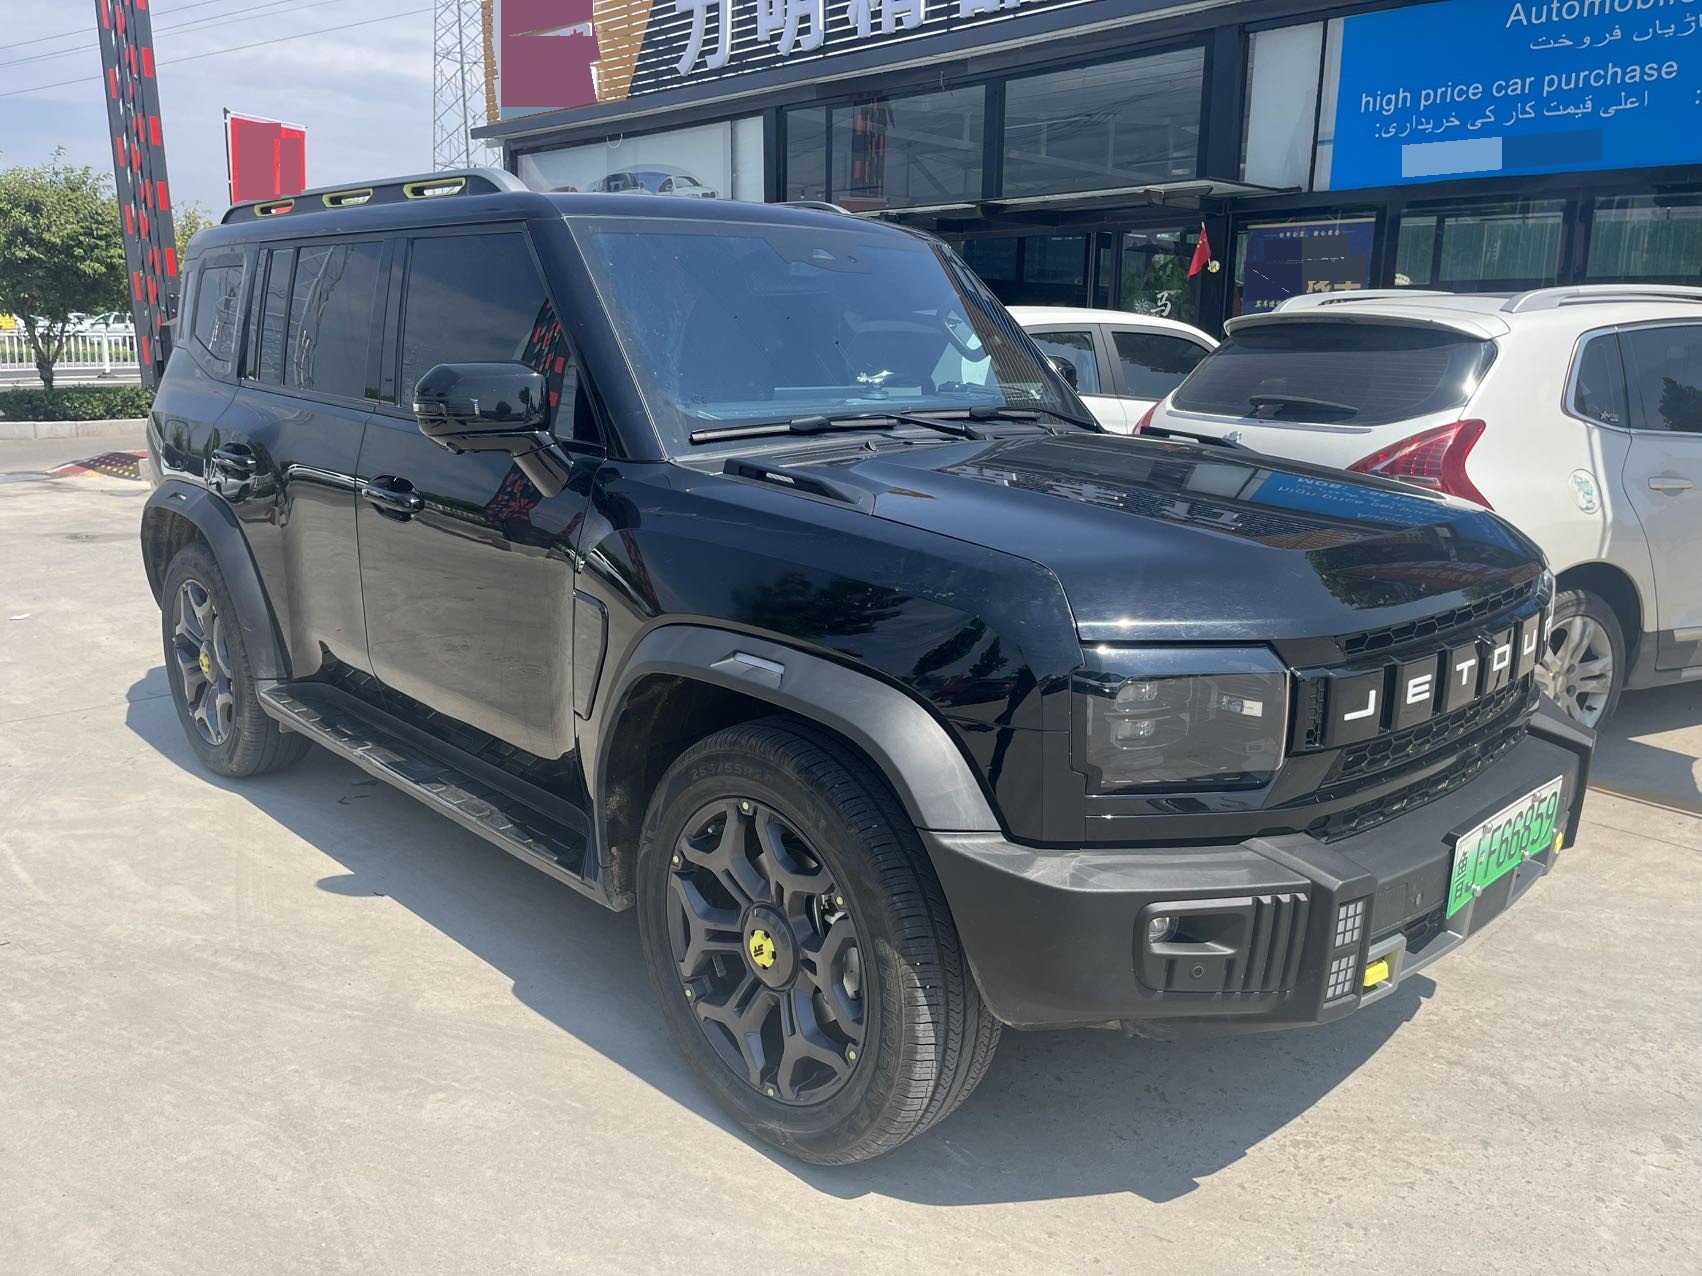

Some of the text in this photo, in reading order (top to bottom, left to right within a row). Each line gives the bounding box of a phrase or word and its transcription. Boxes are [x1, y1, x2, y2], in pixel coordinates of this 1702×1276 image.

[1361, 92, 1411, 116] high
[1420, 82, 1483, 111] price
[1492, 77, 1535, 97] car
[1543, 60, 1679, 97] purchase
[1343, 615, 1553, 722] JETOUR
